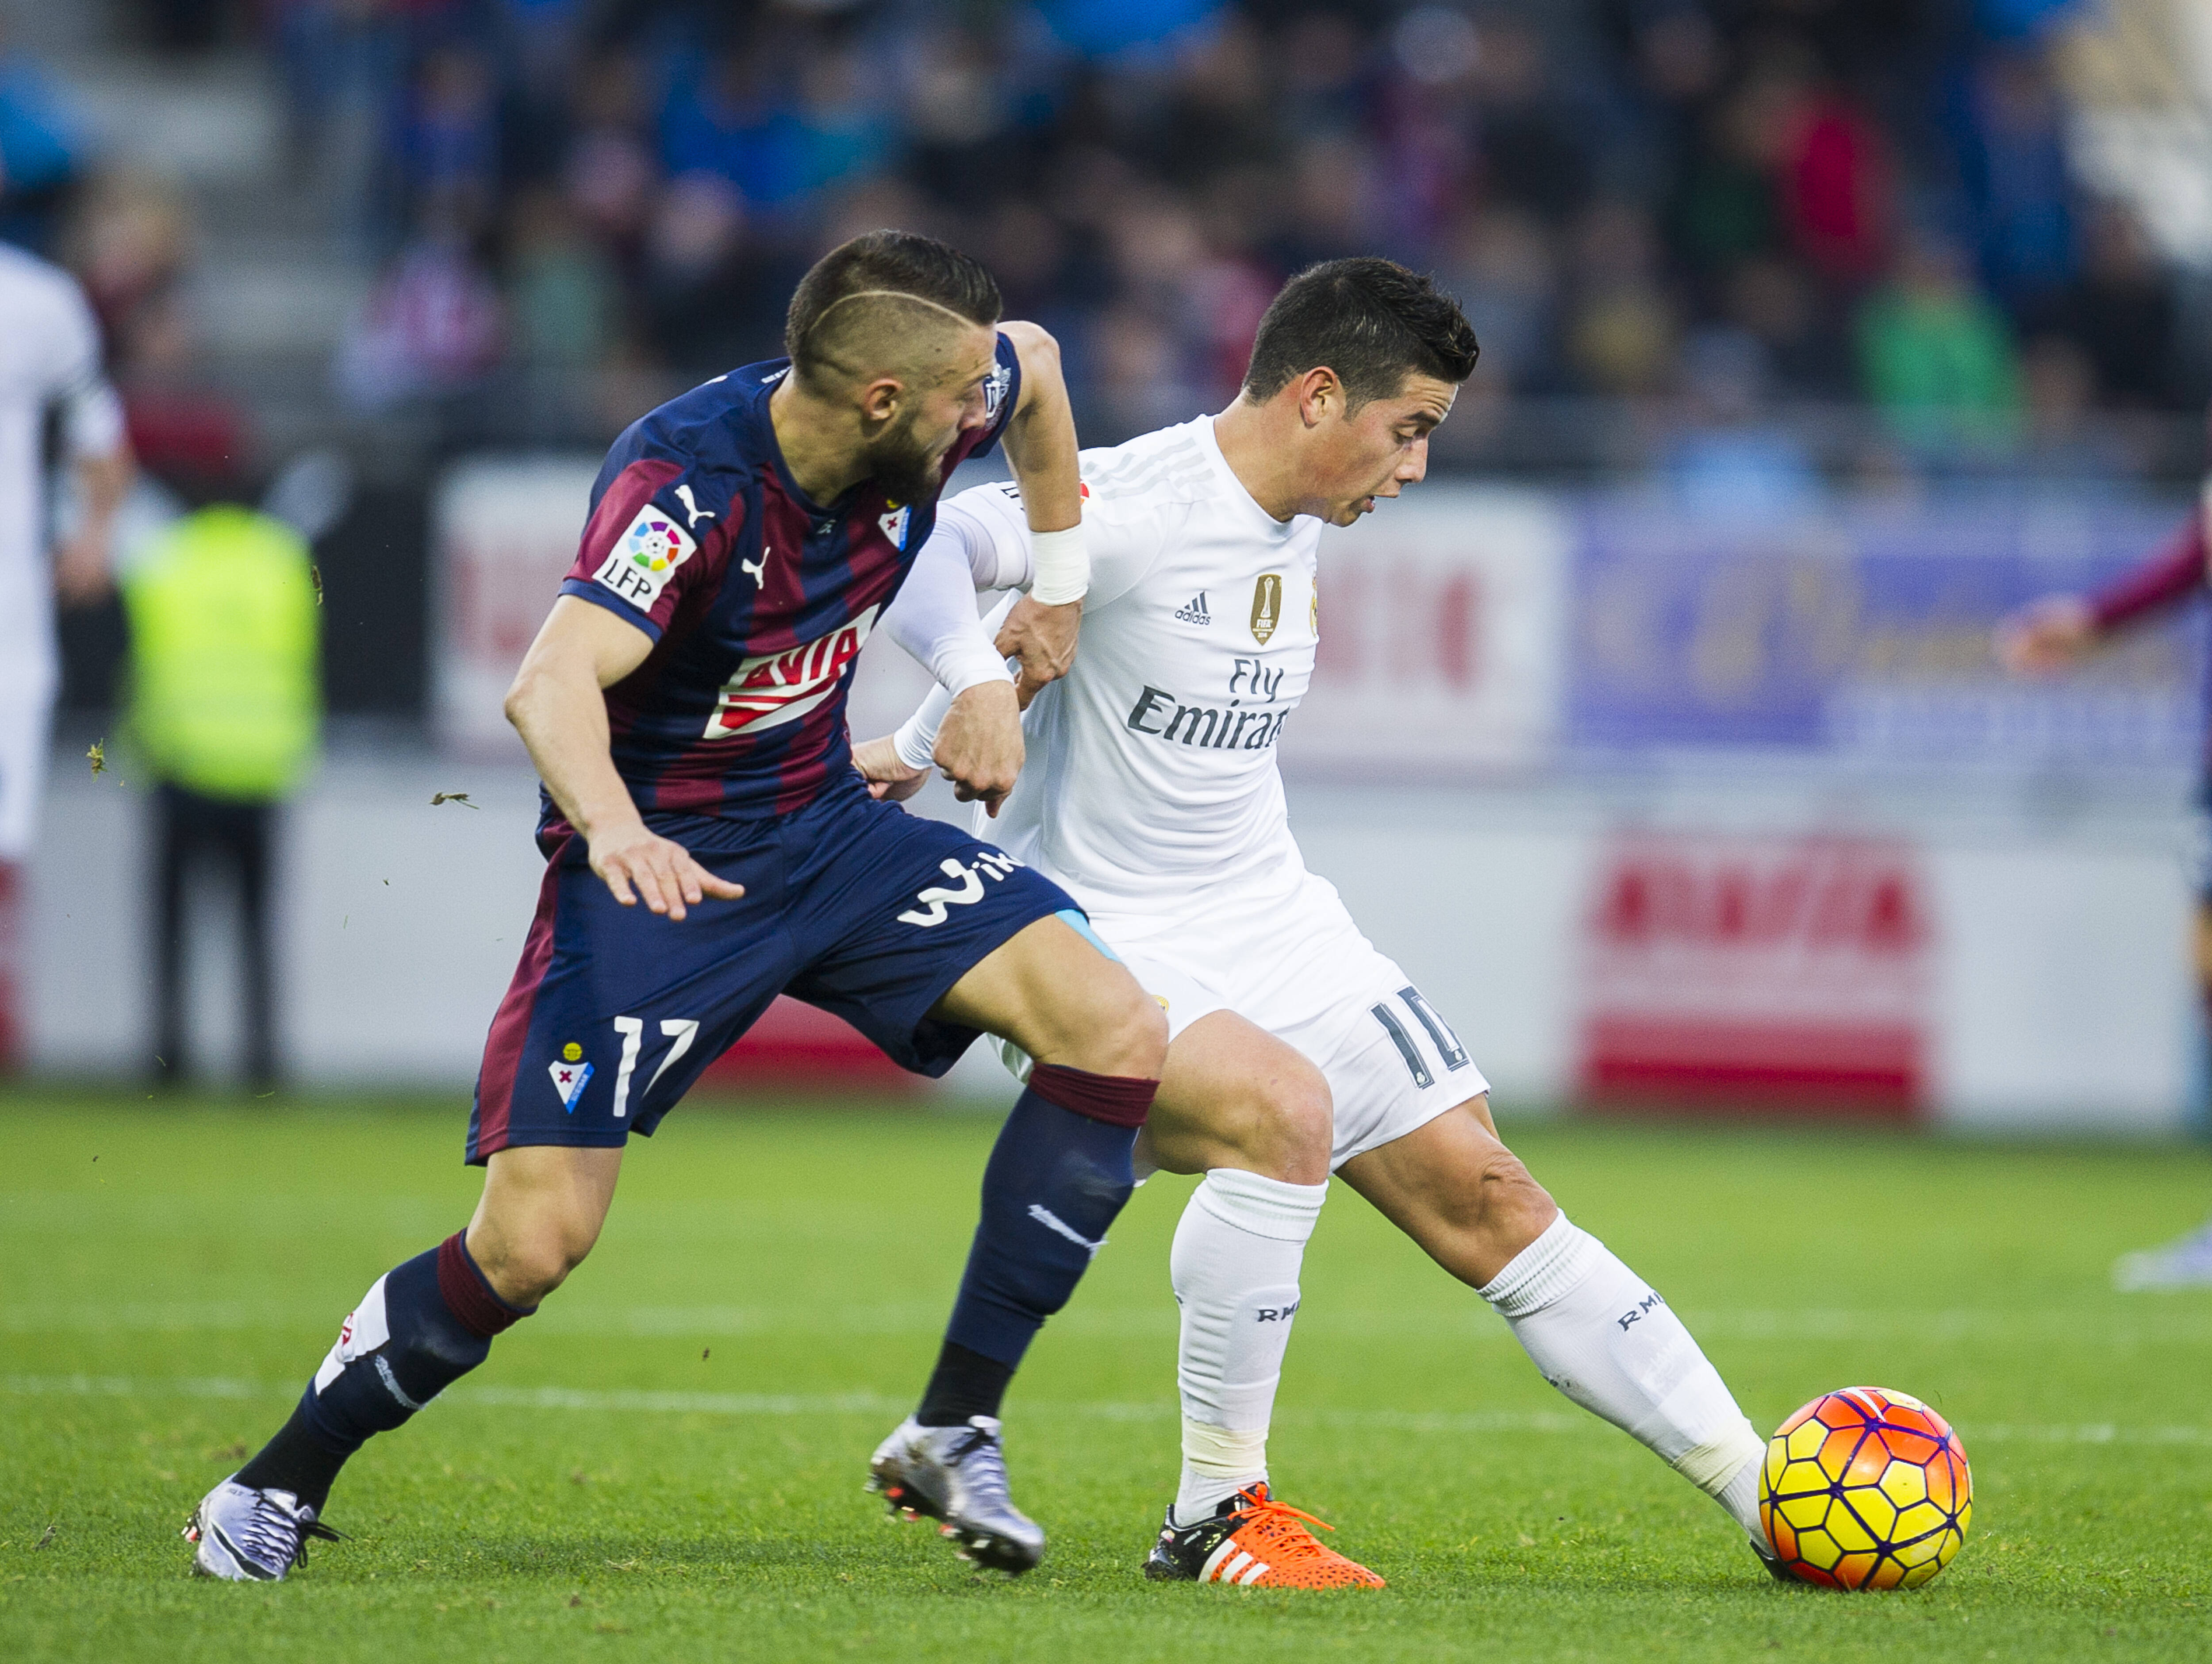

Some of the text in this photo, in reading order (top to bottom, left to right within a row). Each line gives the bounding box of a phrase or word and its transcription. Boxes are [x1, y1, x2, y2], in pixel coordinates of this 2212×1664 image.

[603, 558, 652, 598] LFP
[1175, 610, 1211, 625] adidas
[741, 626, 858, 688] AVIA
[1230, 659, 1284, 703] Fly
[897, 852, 1026, 927] Wik
[614, 1016, 699, 1117] 17
[1257, 1301, 1300, 1322] RM
